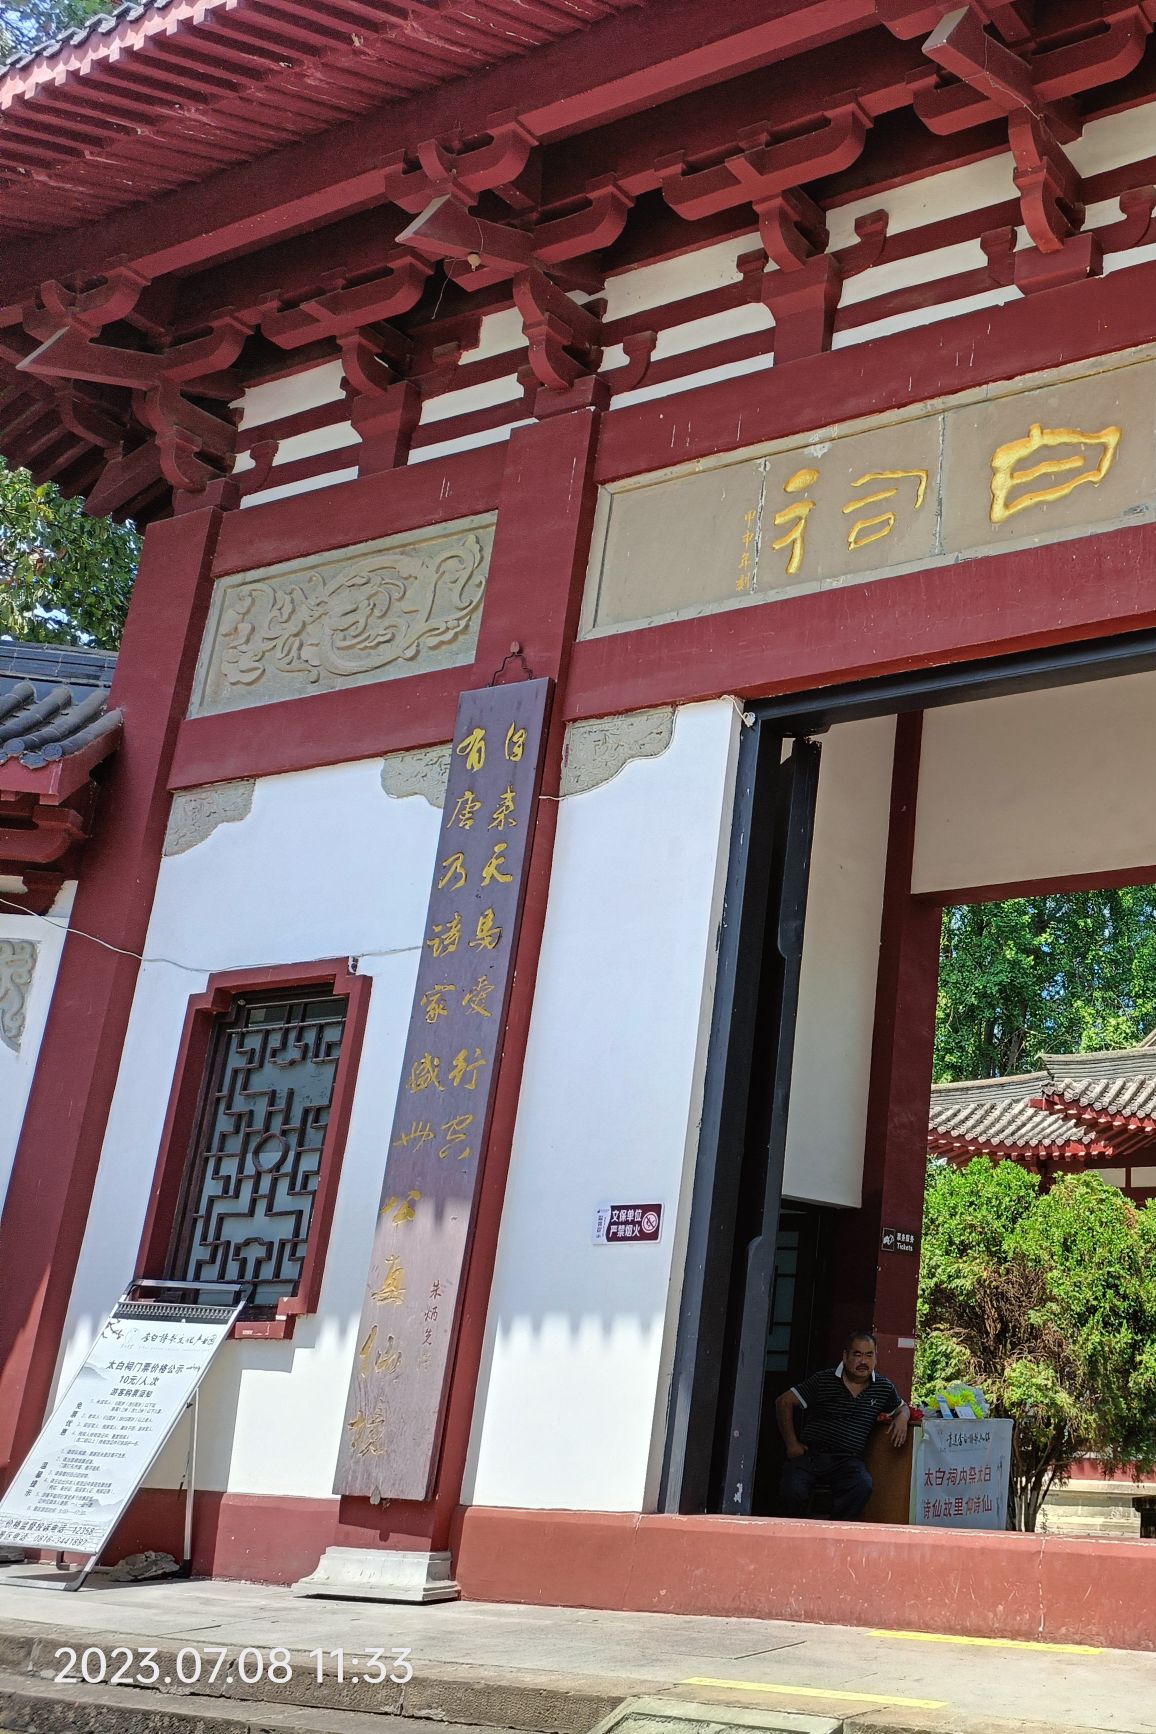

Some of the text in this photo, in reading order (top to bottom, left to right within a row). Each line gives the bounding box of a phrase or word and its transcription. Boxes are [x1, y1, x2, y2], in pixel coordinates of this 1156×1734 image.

[611, 1208, 643, 1223] 文保单位
[608, 1223, 641, 1238] 严禁烟火
[896, 1242, 913, 1252] Tickets
[105, 1359, 185, 1375] 太白祠门票价格公示
[924, 1464, 992, 1488] 太白祠内祭太白
